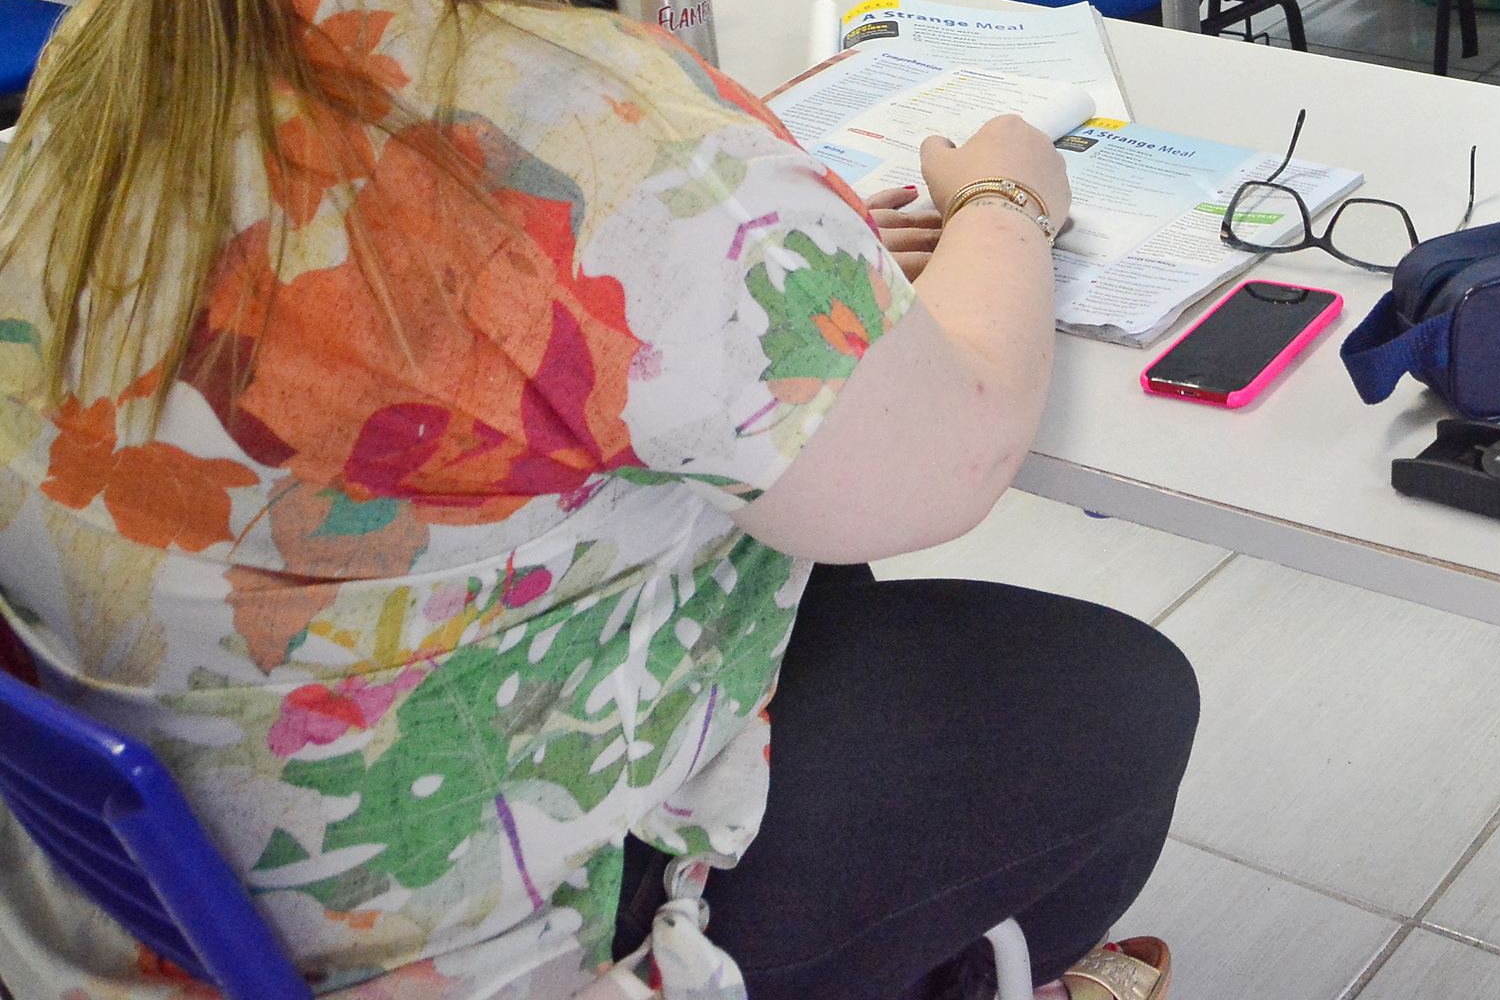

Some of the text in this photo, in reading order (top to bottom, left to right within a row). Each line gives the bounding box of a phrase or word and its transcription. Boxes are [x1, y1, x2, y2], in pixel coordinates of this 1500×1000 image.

[863, 10, 1025, 32] A Strange Meal
[881, 52, 943, 71] Comprehension
[1097, 131, 1156, 150] Strange
[1158, 144, 1196, 158] Meal
